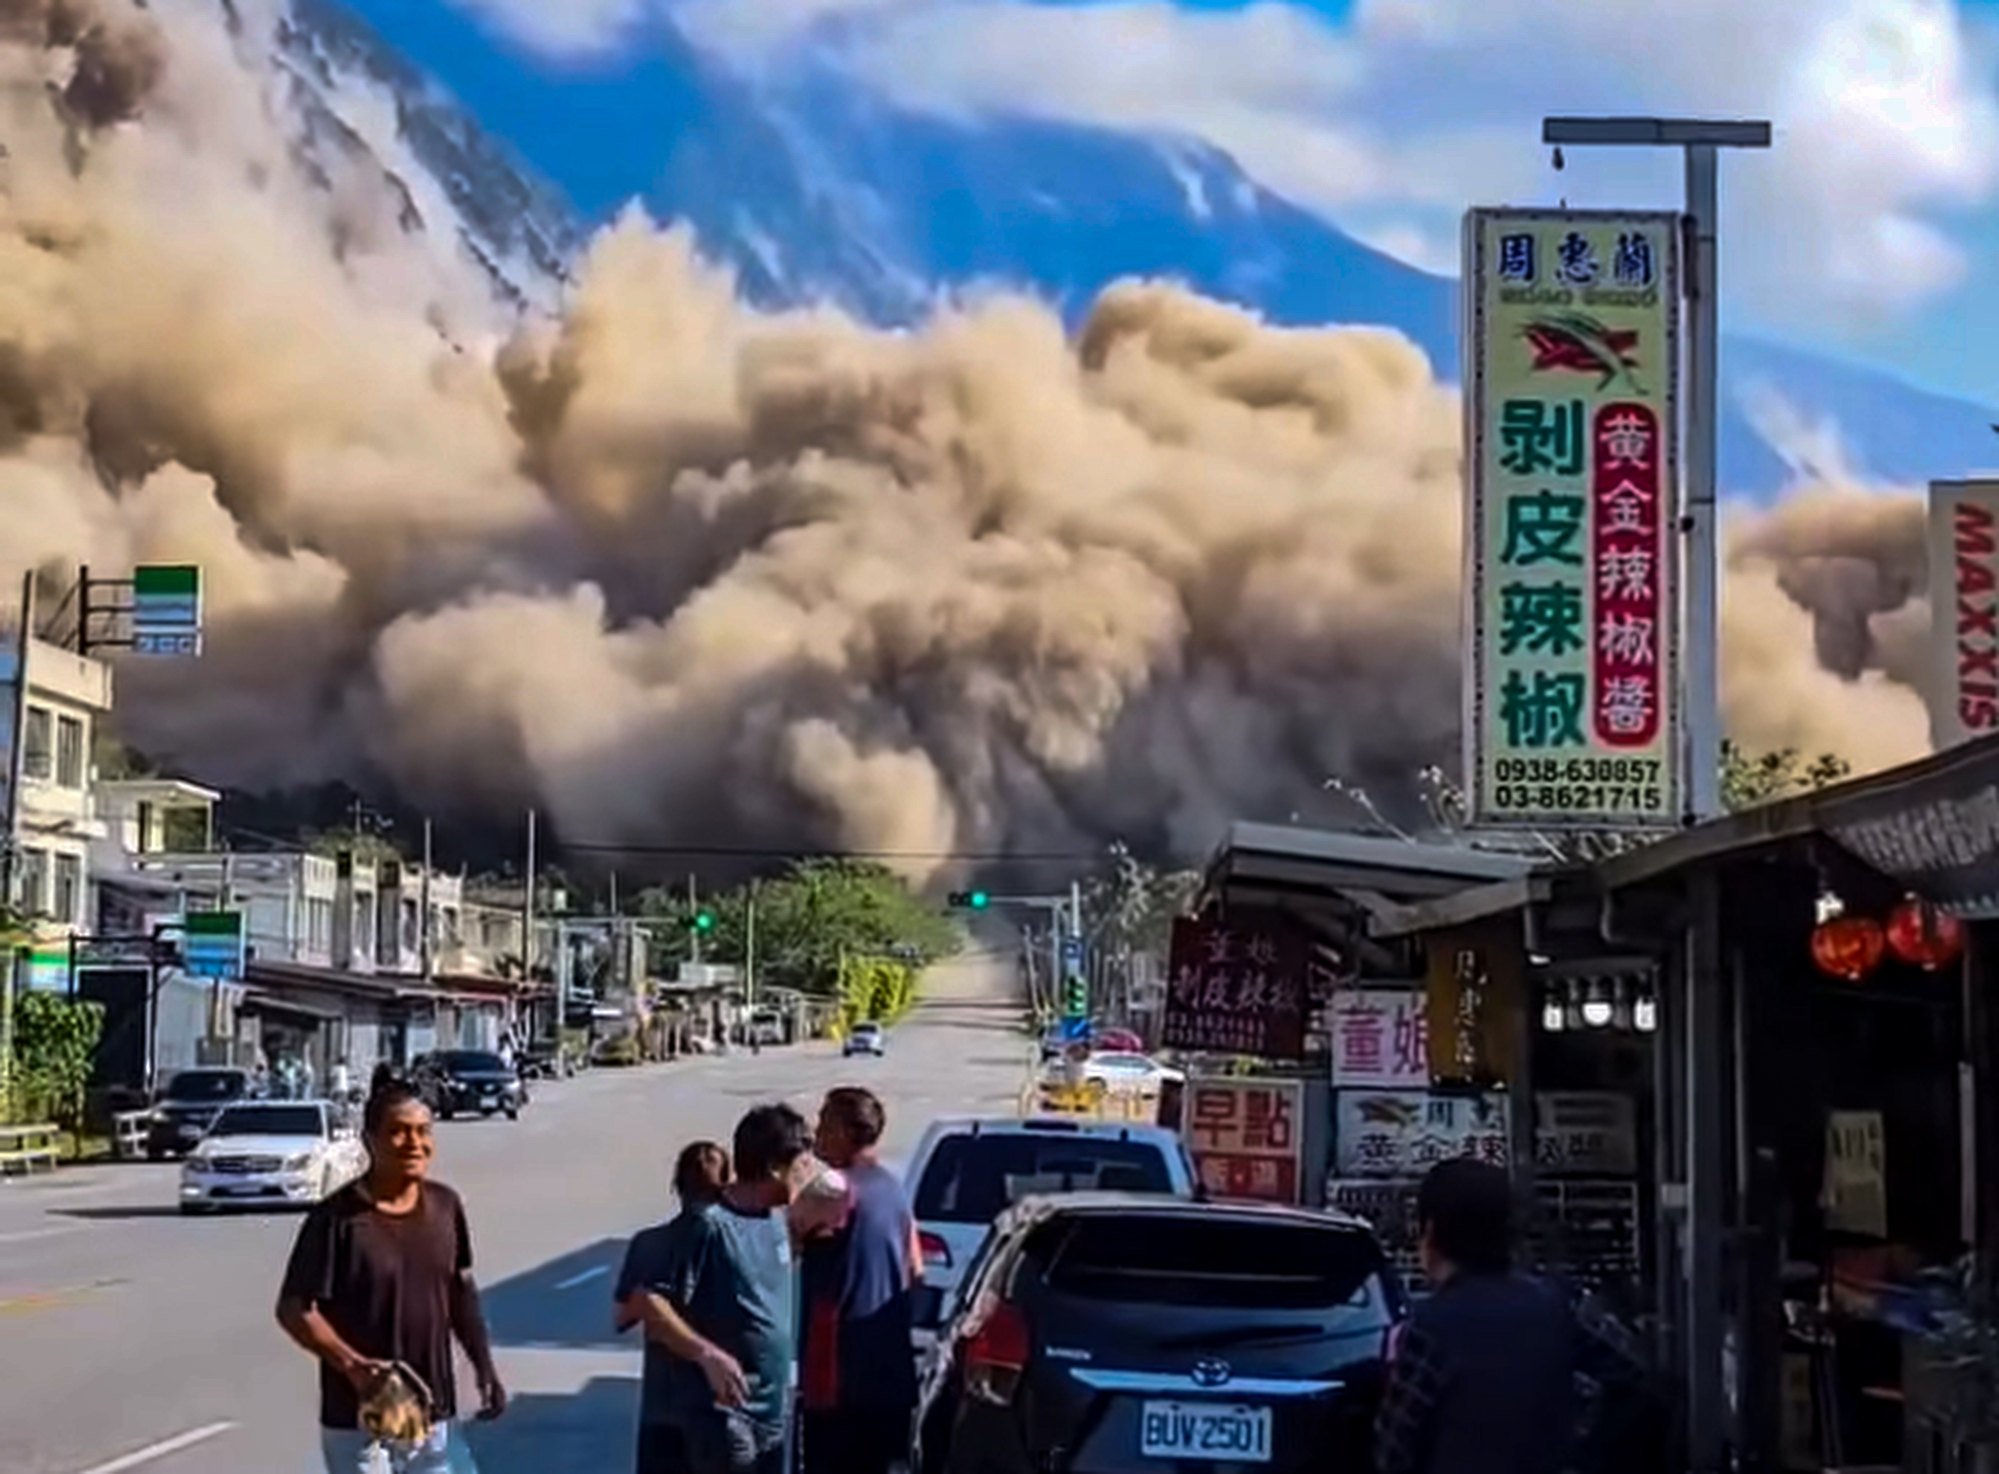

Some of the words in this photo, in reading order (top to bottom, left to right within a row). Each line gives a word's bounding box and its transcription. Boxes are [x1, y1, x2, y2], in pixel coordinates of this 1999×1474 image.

[1955, 503, 1998, 728] MAXXIS
[1495, 785, 1661, 810] 03-8621715
[1193, 1089, 1290, 1148] 早點
